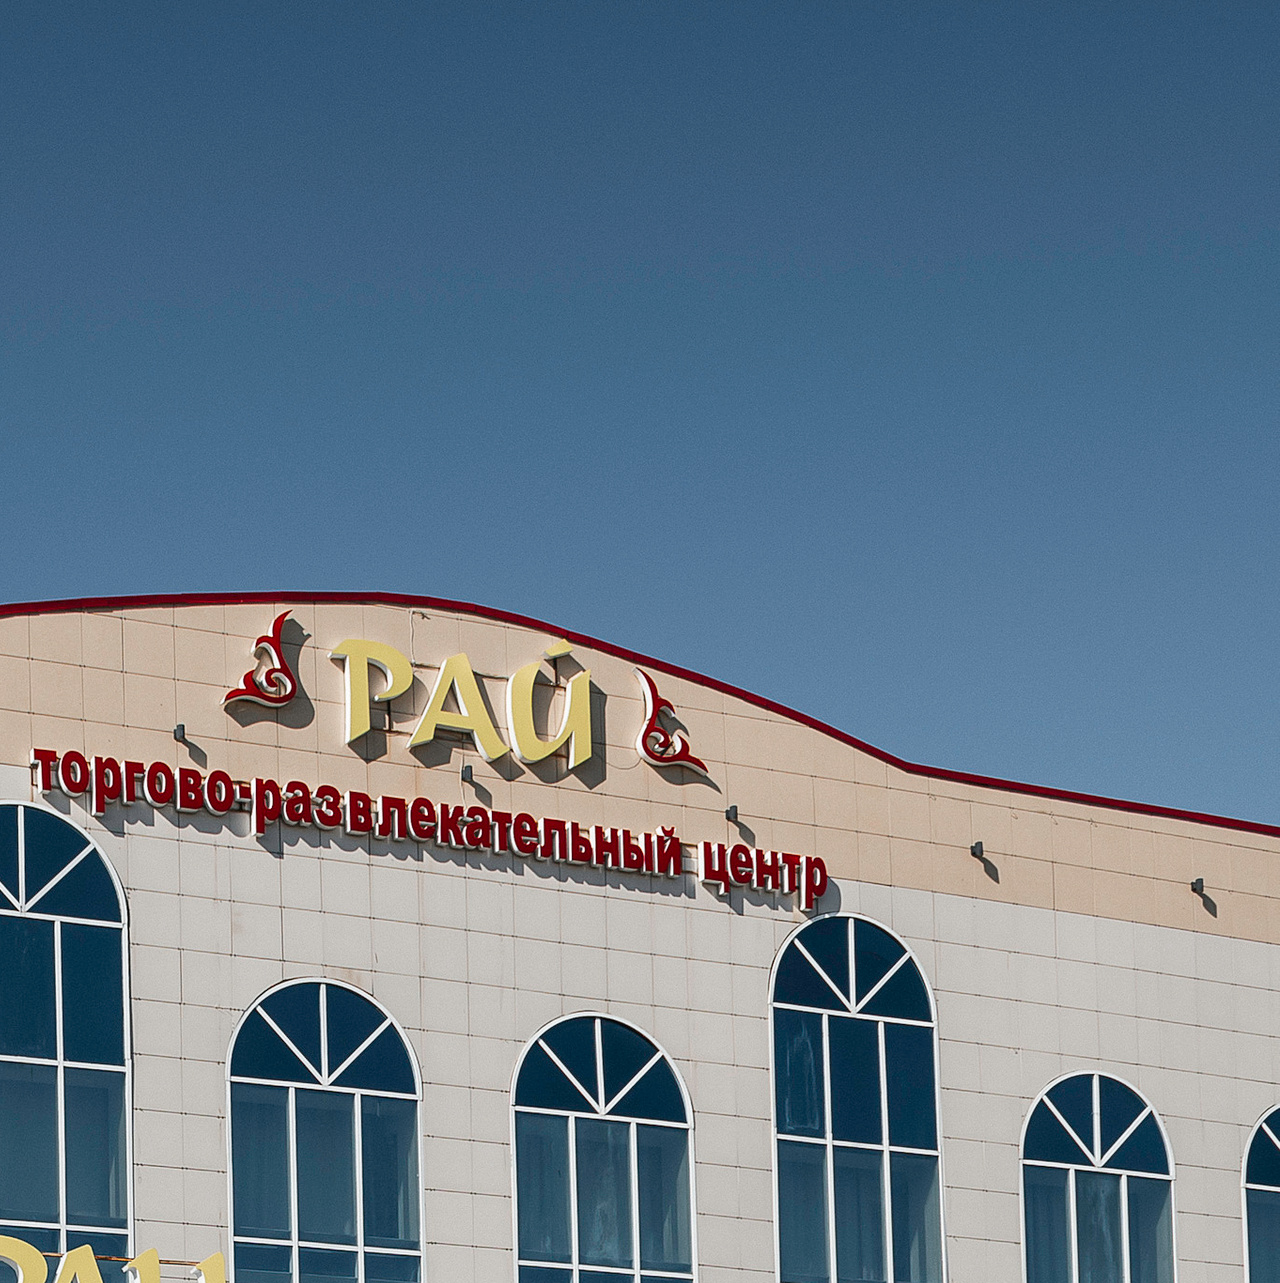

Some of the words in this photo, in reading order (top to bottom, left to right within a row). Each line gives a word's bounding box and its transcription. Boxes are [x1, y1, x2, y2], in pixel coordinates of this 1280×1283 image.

[328, 638, 593, 771] РАЙ
[31, 747, 684, 880] торгово-развлекательный
[699, 839, 829, 912] центр
